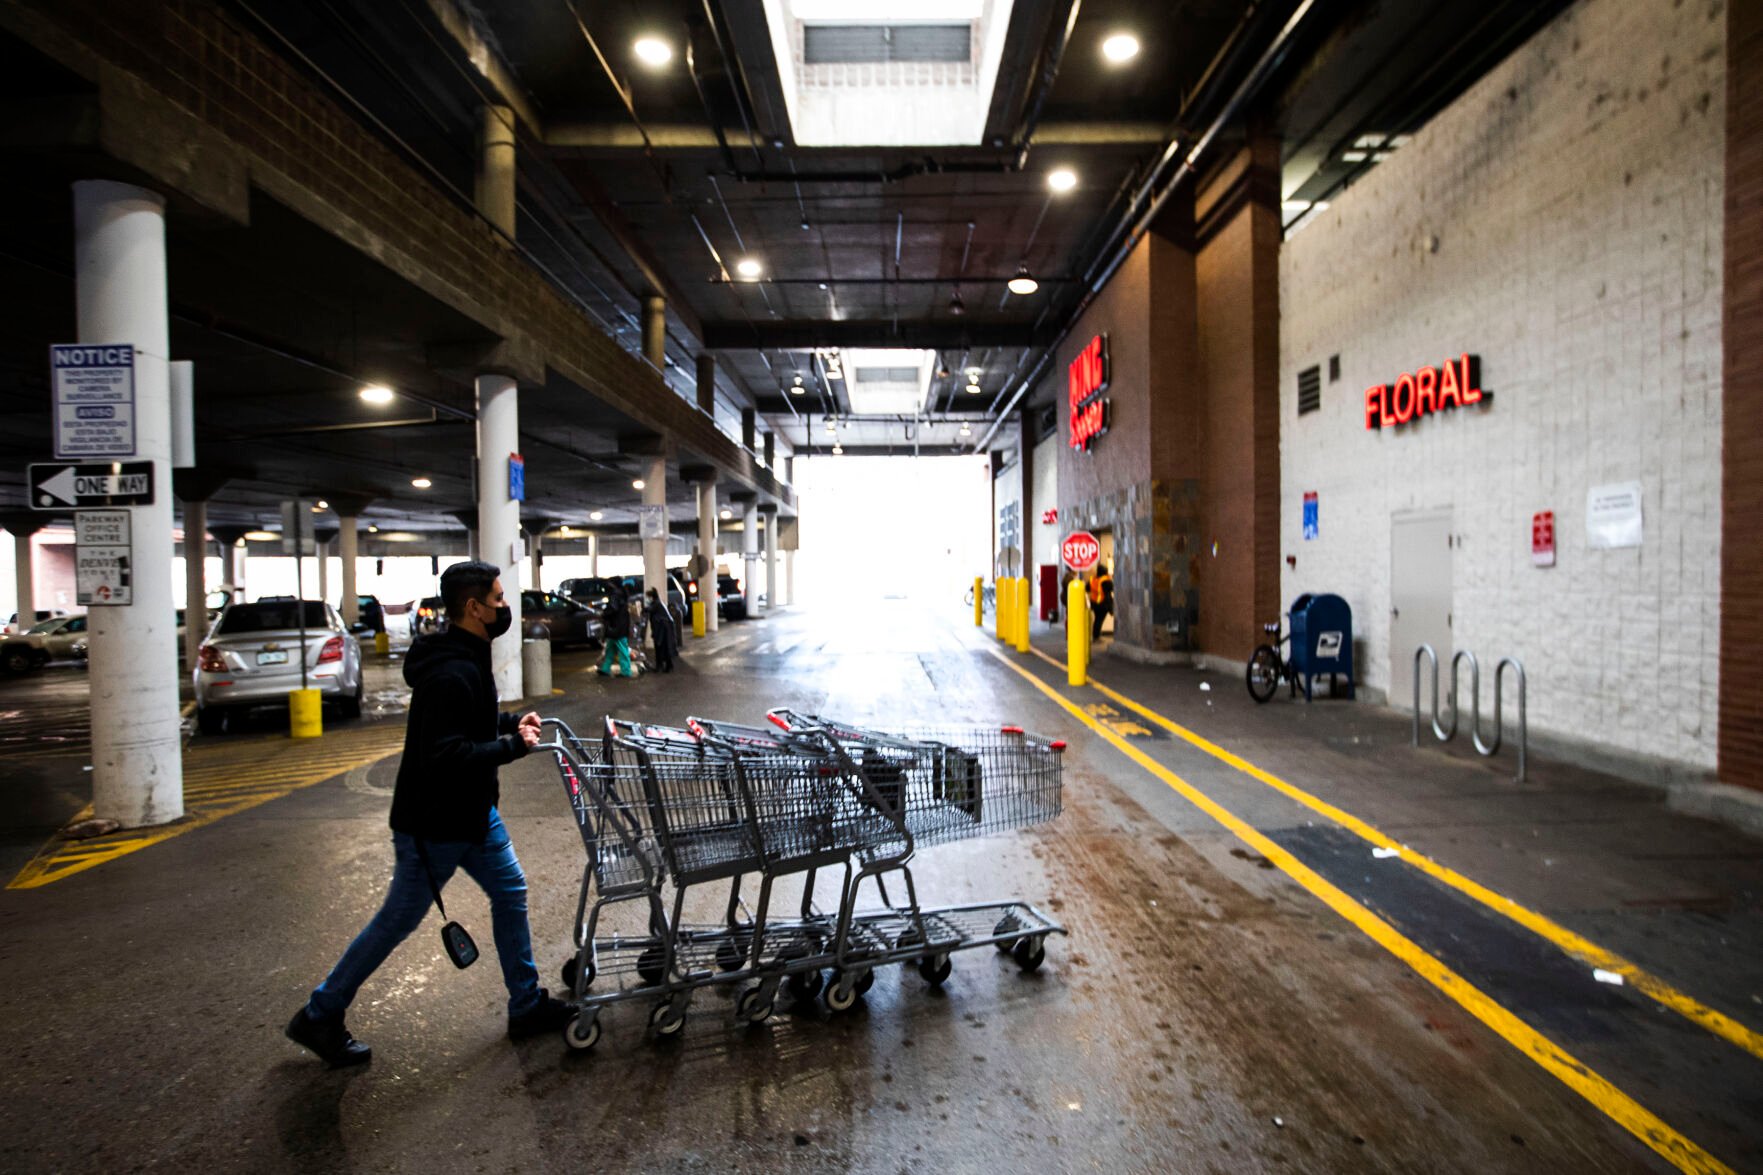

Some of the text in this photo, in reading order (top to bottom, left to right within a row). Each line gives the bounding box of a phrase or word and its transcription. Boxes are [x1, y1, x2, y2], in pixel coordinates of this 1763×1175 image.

[55, 349, 131, 365] NOTICE
[83, 369, 123, 377] PROPERTY
[65, 377, 111, 385] MONITORED
[1364, 351, 1483, 432] FLORAL
[78, 408, 114, 417] AVISO
[75, 475, 147, 495] ONE WAY
[79, 515, 124, 523] PARKWAY
[85, 524, 120, 533] OFFICE
[84, 534, 120, 542] CENTRE
[1064, 542, 1097, 560] STOP
[79, 557, 120, 568] DENVE
